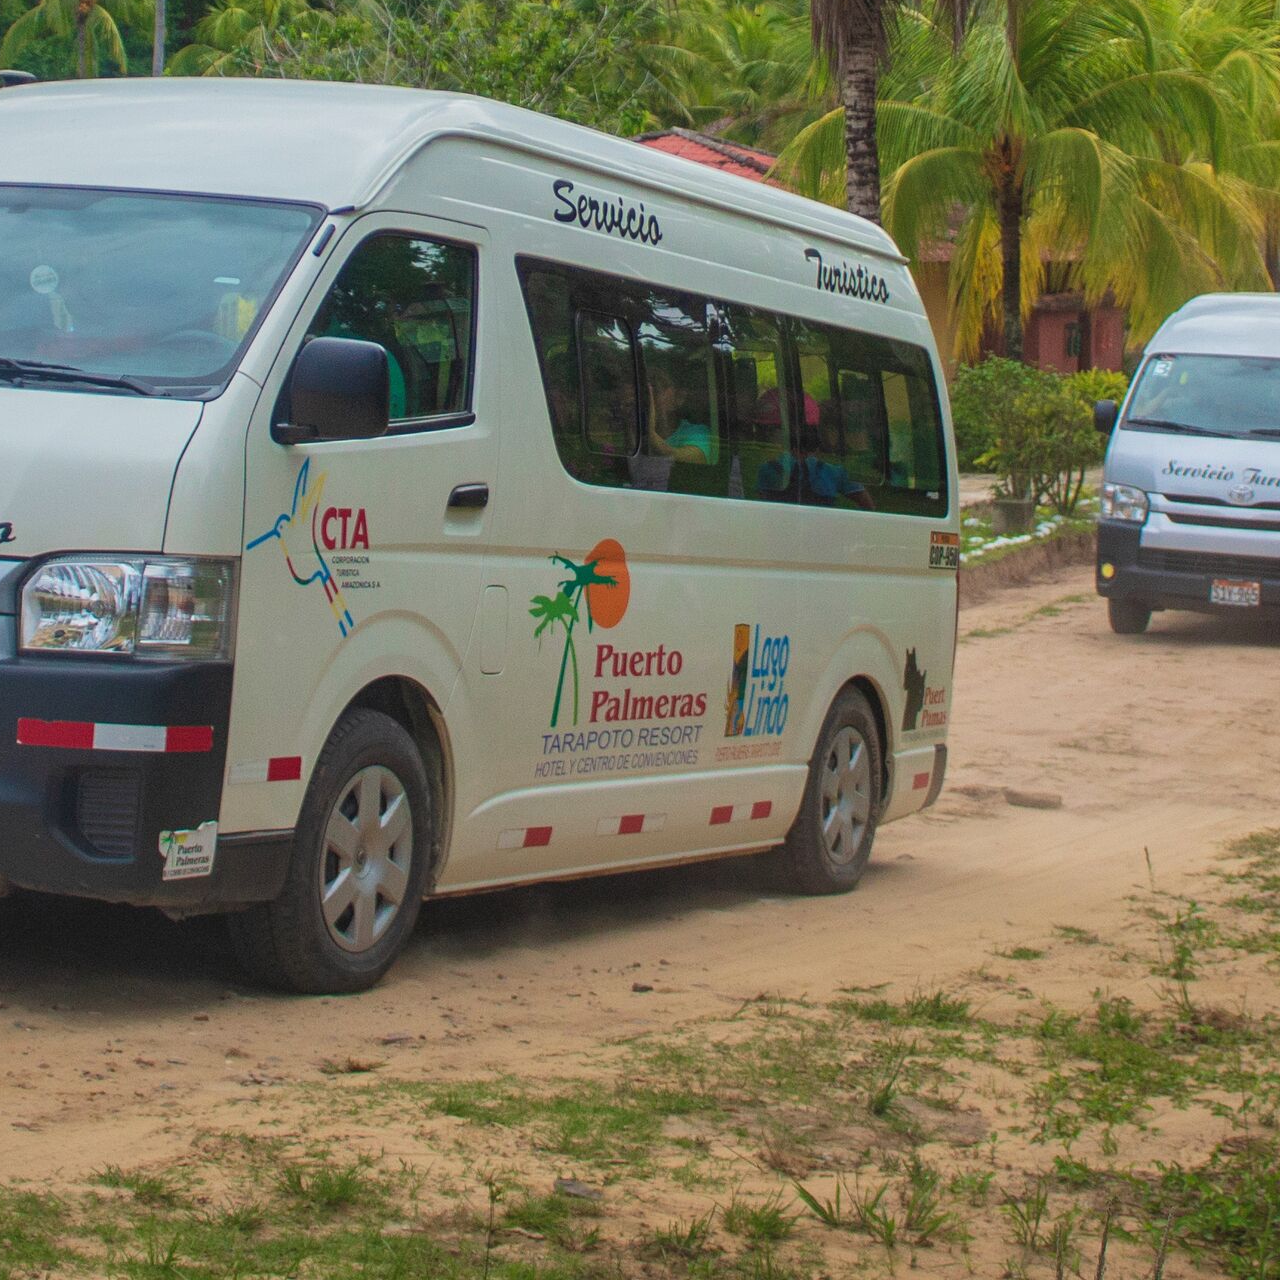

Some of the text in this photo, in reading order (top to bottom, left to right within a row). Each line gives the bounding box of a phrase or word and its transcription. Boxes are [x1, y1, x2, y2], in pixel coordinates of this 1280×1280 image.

[553, 179, 890, 304] Servicio Turistico
[1162, 460, 1234, 481] Servicio
[321, 506, 369, 550] CTA
[594, 644, 683, 678] Puerto
[751, 623, 790, 691] Lago
[589, 688, 707, 723] Palmeras
[743, 680, 789, 737] Lindo
[542, 725, 703, 755] TARAPOTO RESORT
[534, 758, 568, 778] HOTEL
[568, 758, 578, 774] Y
[576, 753, 617, 772] CENTRO
[616, 753, 630, 770] DE
[631, 748, 699, 768] CONVENCIONES
